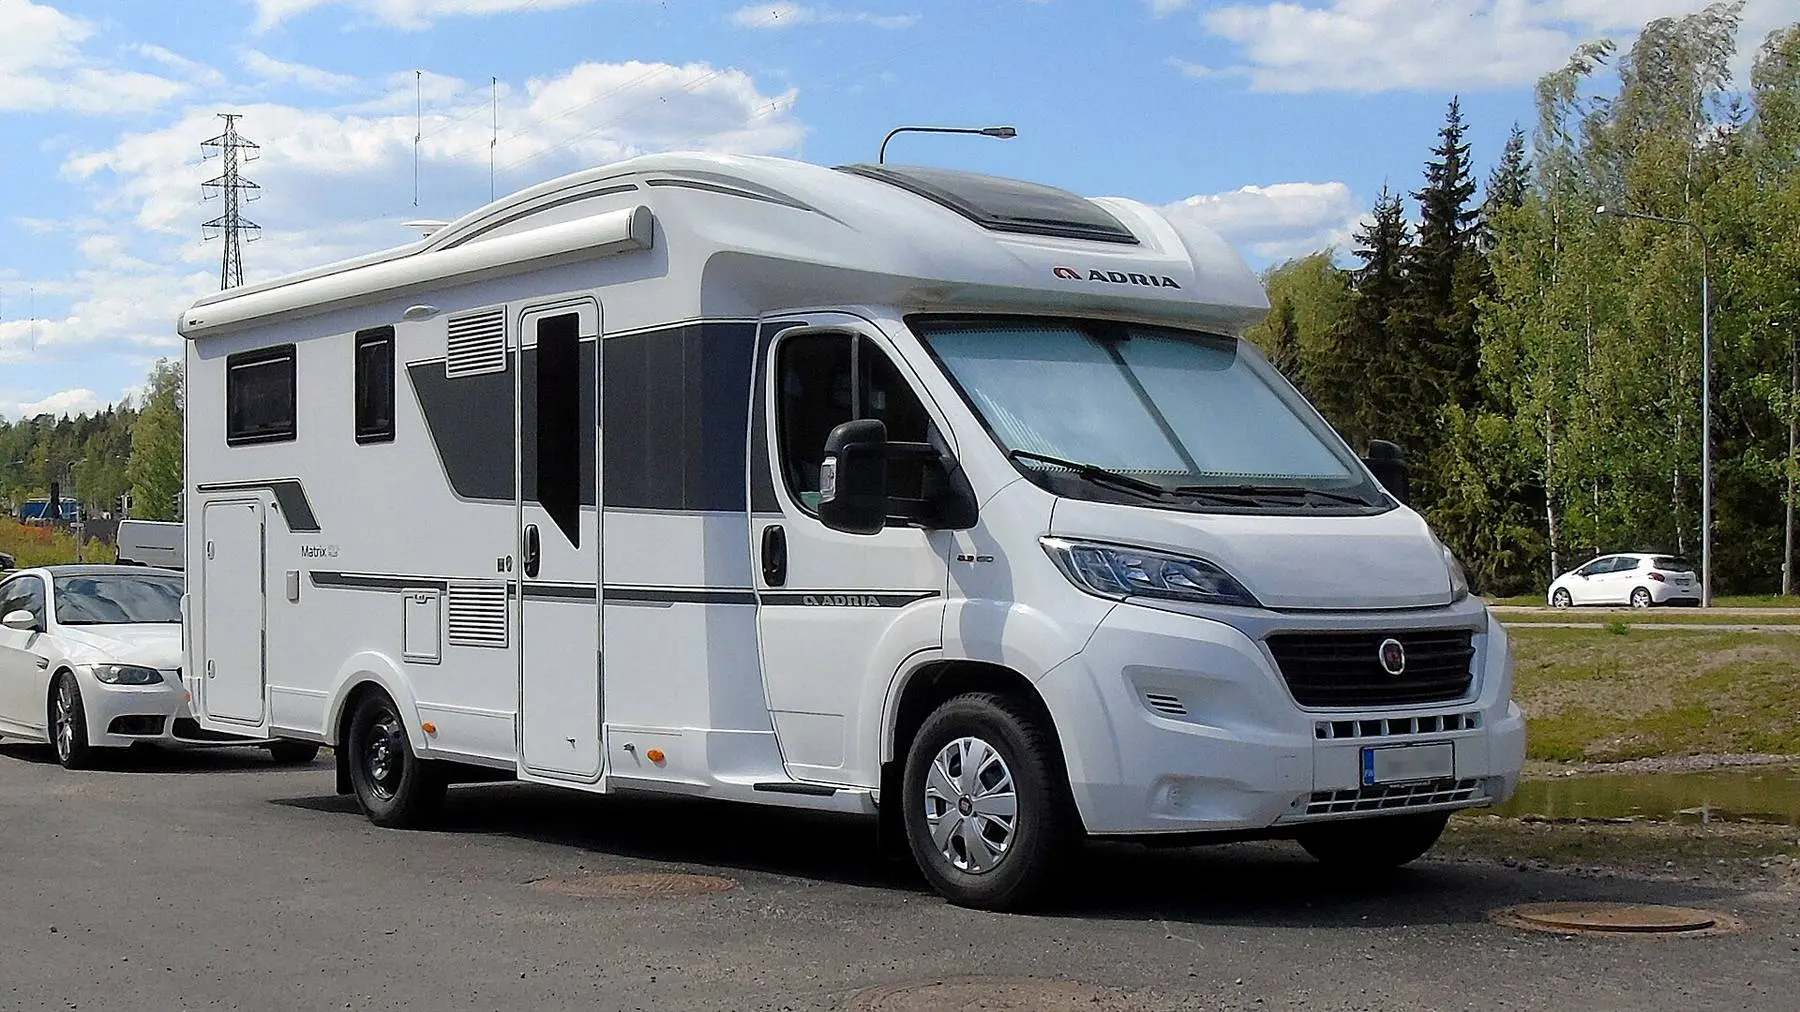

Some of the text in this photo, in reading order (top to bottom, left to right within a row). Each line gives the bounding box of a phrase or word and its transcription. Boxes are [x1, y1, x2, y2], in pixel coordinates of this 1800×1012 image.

[1088, 269, 1182, 289] ADRIA
[301, 545, 327, 557] Matrix
[821, 595, 881, 607] ADRIA
